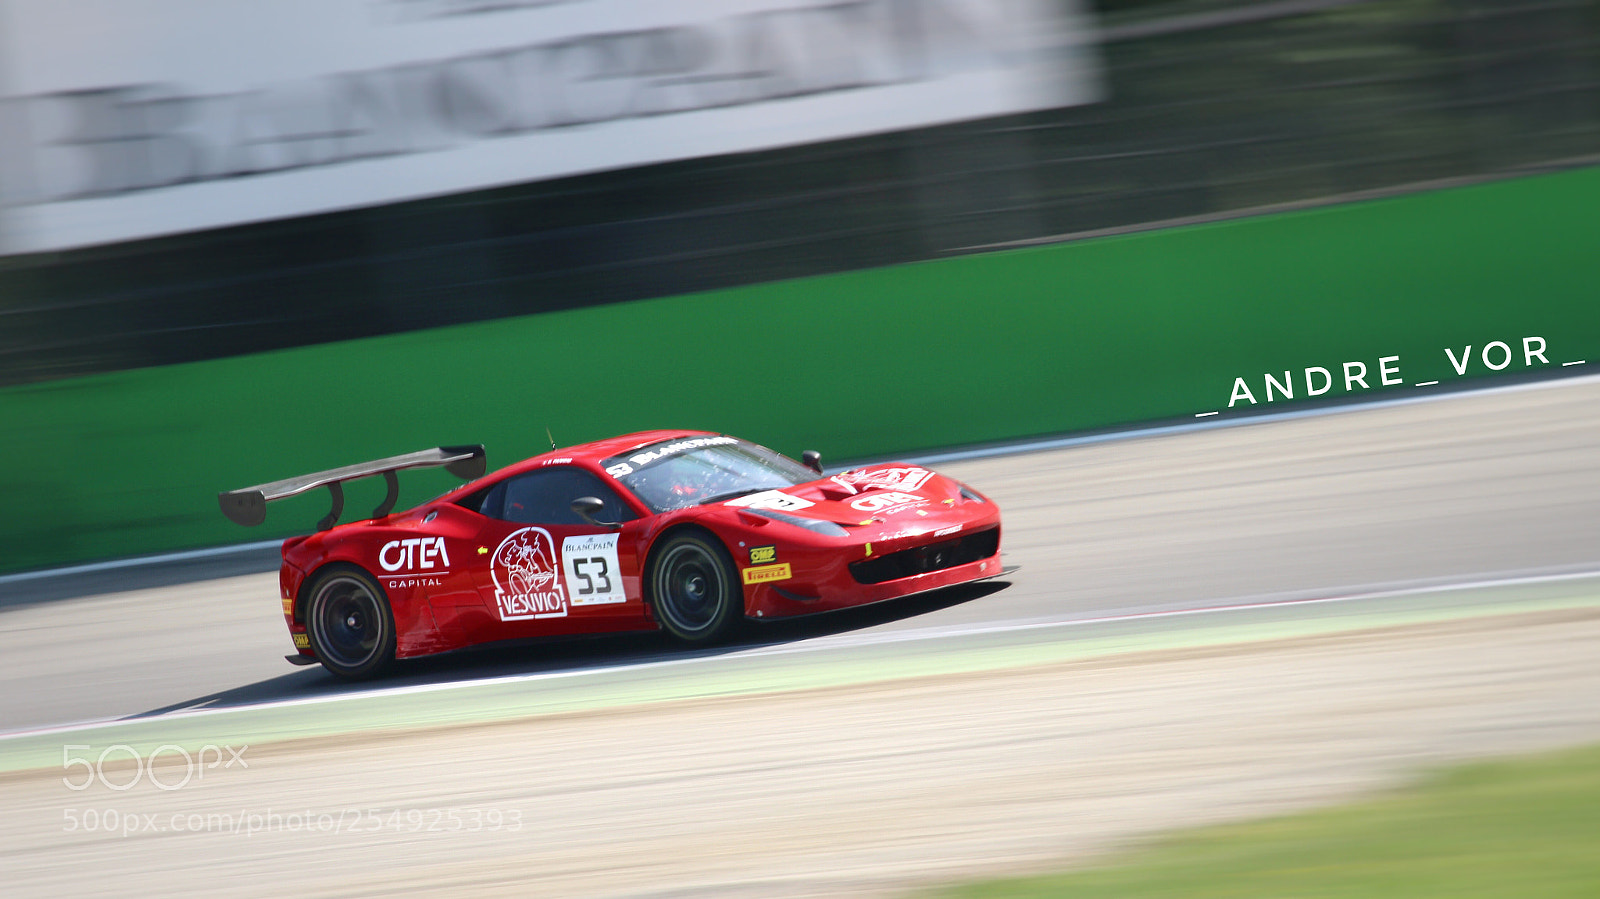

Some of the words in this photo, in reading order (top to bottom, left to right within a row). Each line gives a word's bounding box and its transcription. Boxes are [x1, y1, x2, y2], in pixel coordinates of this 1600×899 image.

[565, 541, 614, 552] BLANCPAIN
[750, 549, 775, 561] OMP
[573, 556, 611, 595] 53
[748, 567, 786, 580] PIRELLI
[389, 578, 442, 588] CAPITAL
[502, 591, 560, 615] VESUVIO
